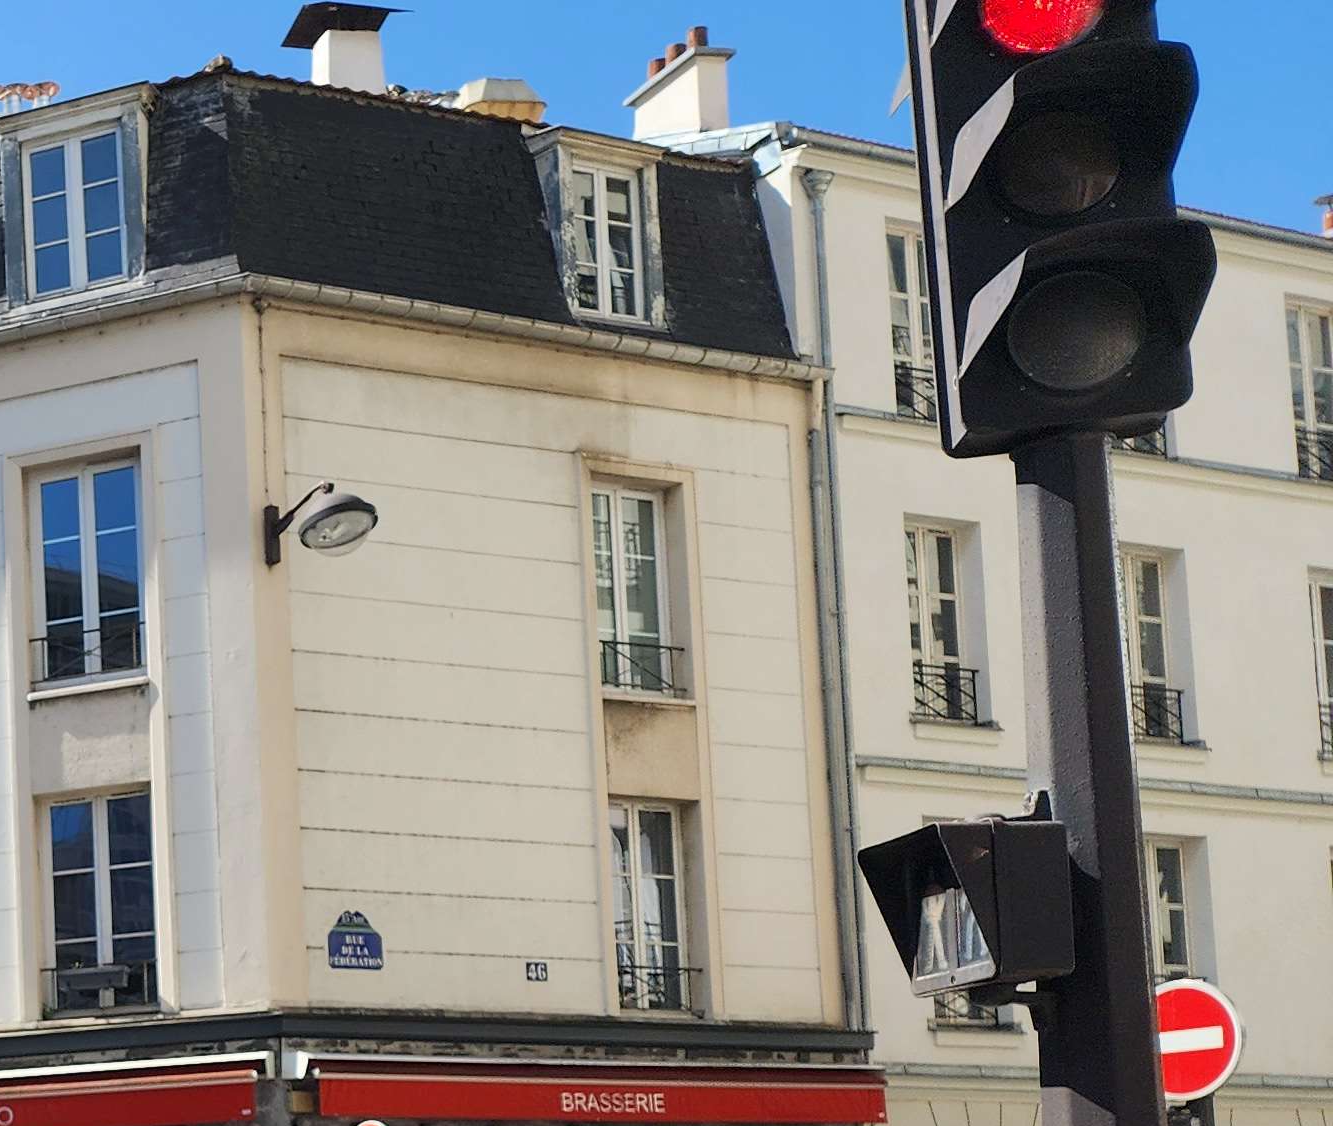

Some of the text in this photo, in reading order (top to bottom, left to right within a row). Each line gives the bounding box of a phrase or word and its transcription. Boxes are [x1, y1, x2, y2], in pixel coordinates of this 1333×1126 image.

[345, 935, 365, 945] RUE
[341, 946, 369, 956] DE LA
[528, 963, 547, 980] 46
[560, 1091, 666, 1113] BRASSERIE
